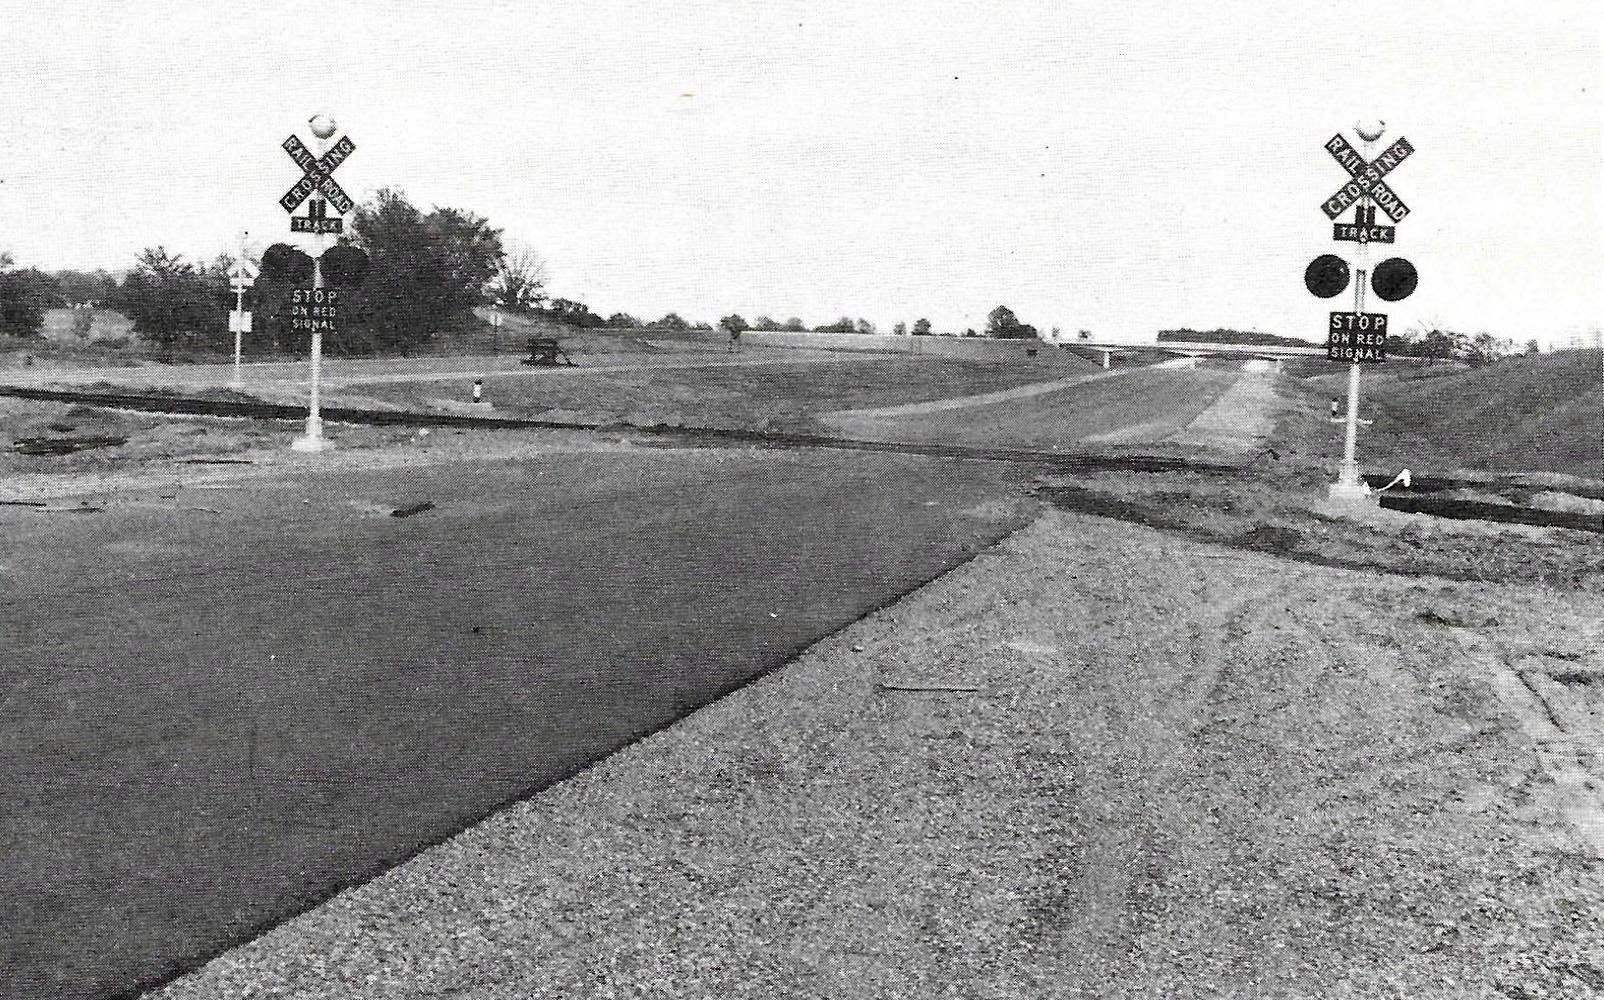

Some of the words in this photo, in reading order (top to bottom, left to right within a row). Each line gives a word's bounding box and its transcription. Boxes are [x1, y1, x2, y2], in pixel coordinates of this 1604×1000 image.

[285, 142, 351, 208] CROSSING
[286, 138, 313, 171] RAIL
[321, 179, 351, 212] ROAD
[1328, 138, 1360, 174] RAIL
[1371, 183, 1405, 220] ROAD
[1328, 145, 1408, 214] CROSSING
[297, 219, 336, 231] TRACK
[1341, 228, 1388, 240] TRACK
[293, 290, 337, 304] STOP
[292, 306, 307, 316] ON
[313, 306, 336, 317] RED
[293, 319, 336, 330] SIGNAL
[1332, 315, 1385, 330] STOP
[1331, 333, 1350, 344] ON
[1356, 334, 1384, 345] RED
[1331, 347, 1382, 360] SIGNAL
